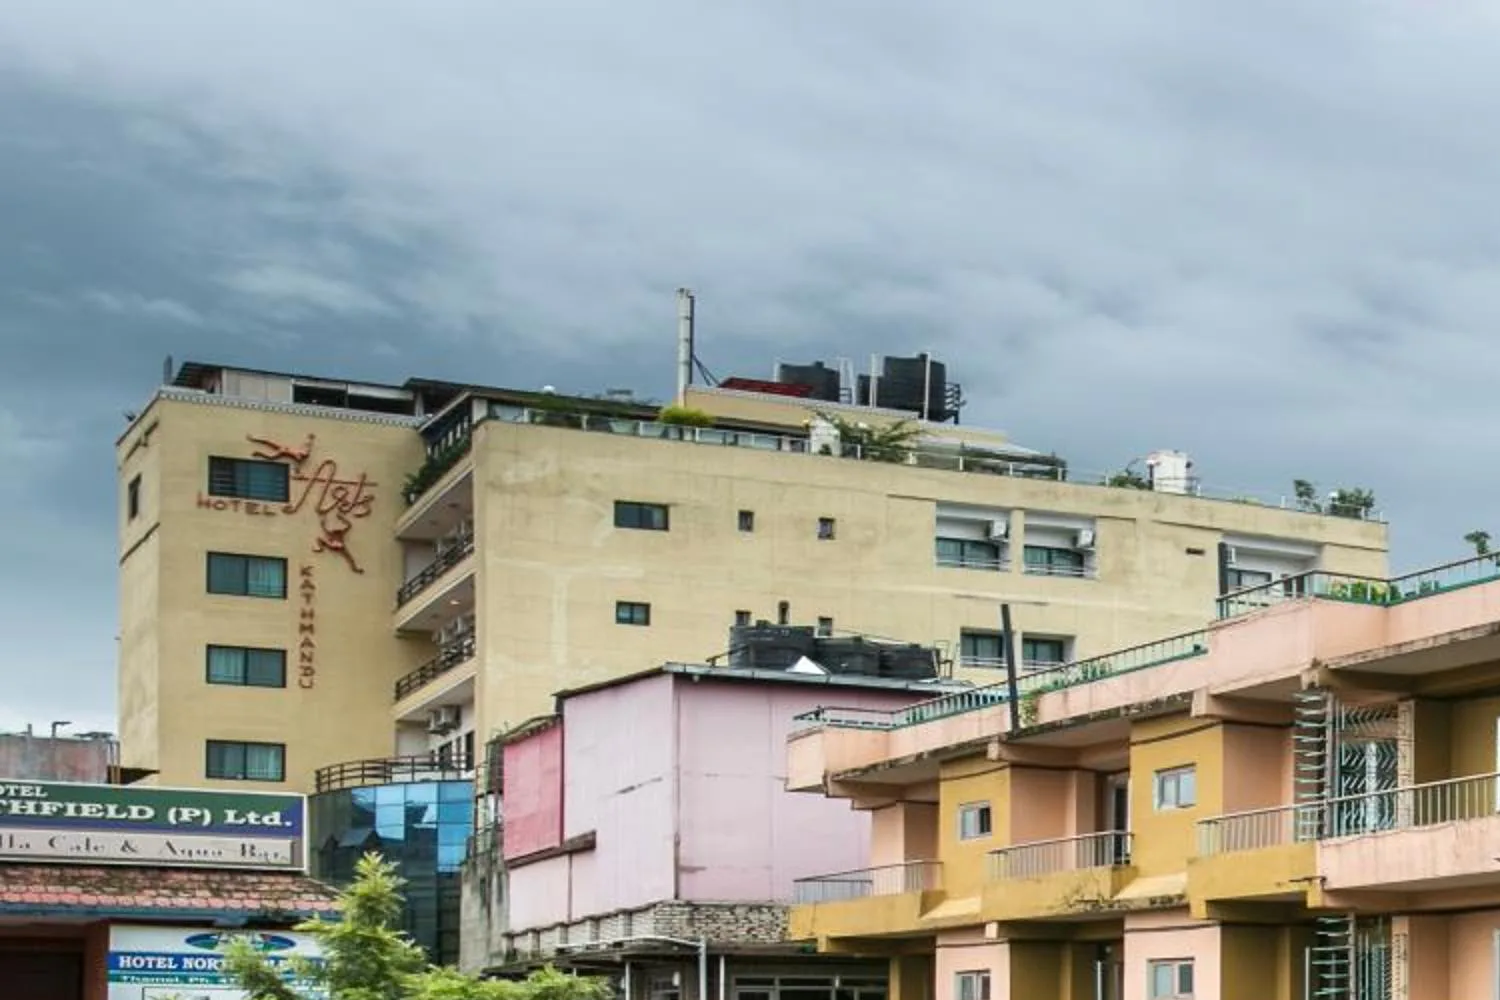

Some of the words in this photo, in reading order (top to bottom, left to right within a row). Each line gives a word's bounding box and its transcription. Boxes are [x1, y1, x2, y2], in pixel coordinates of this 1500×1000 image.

[197, 492, 276, 516] HOTEL
[299, 565, 317, 690] KATHMANDU
[0, 799, 155, 819] HFIELD
[167, 806, 212, 826] (P)
[223, 809, 293, 827] Ltd.
[120, 840, 138, 853] &
[119, 955, 178, 969] HOTEL
